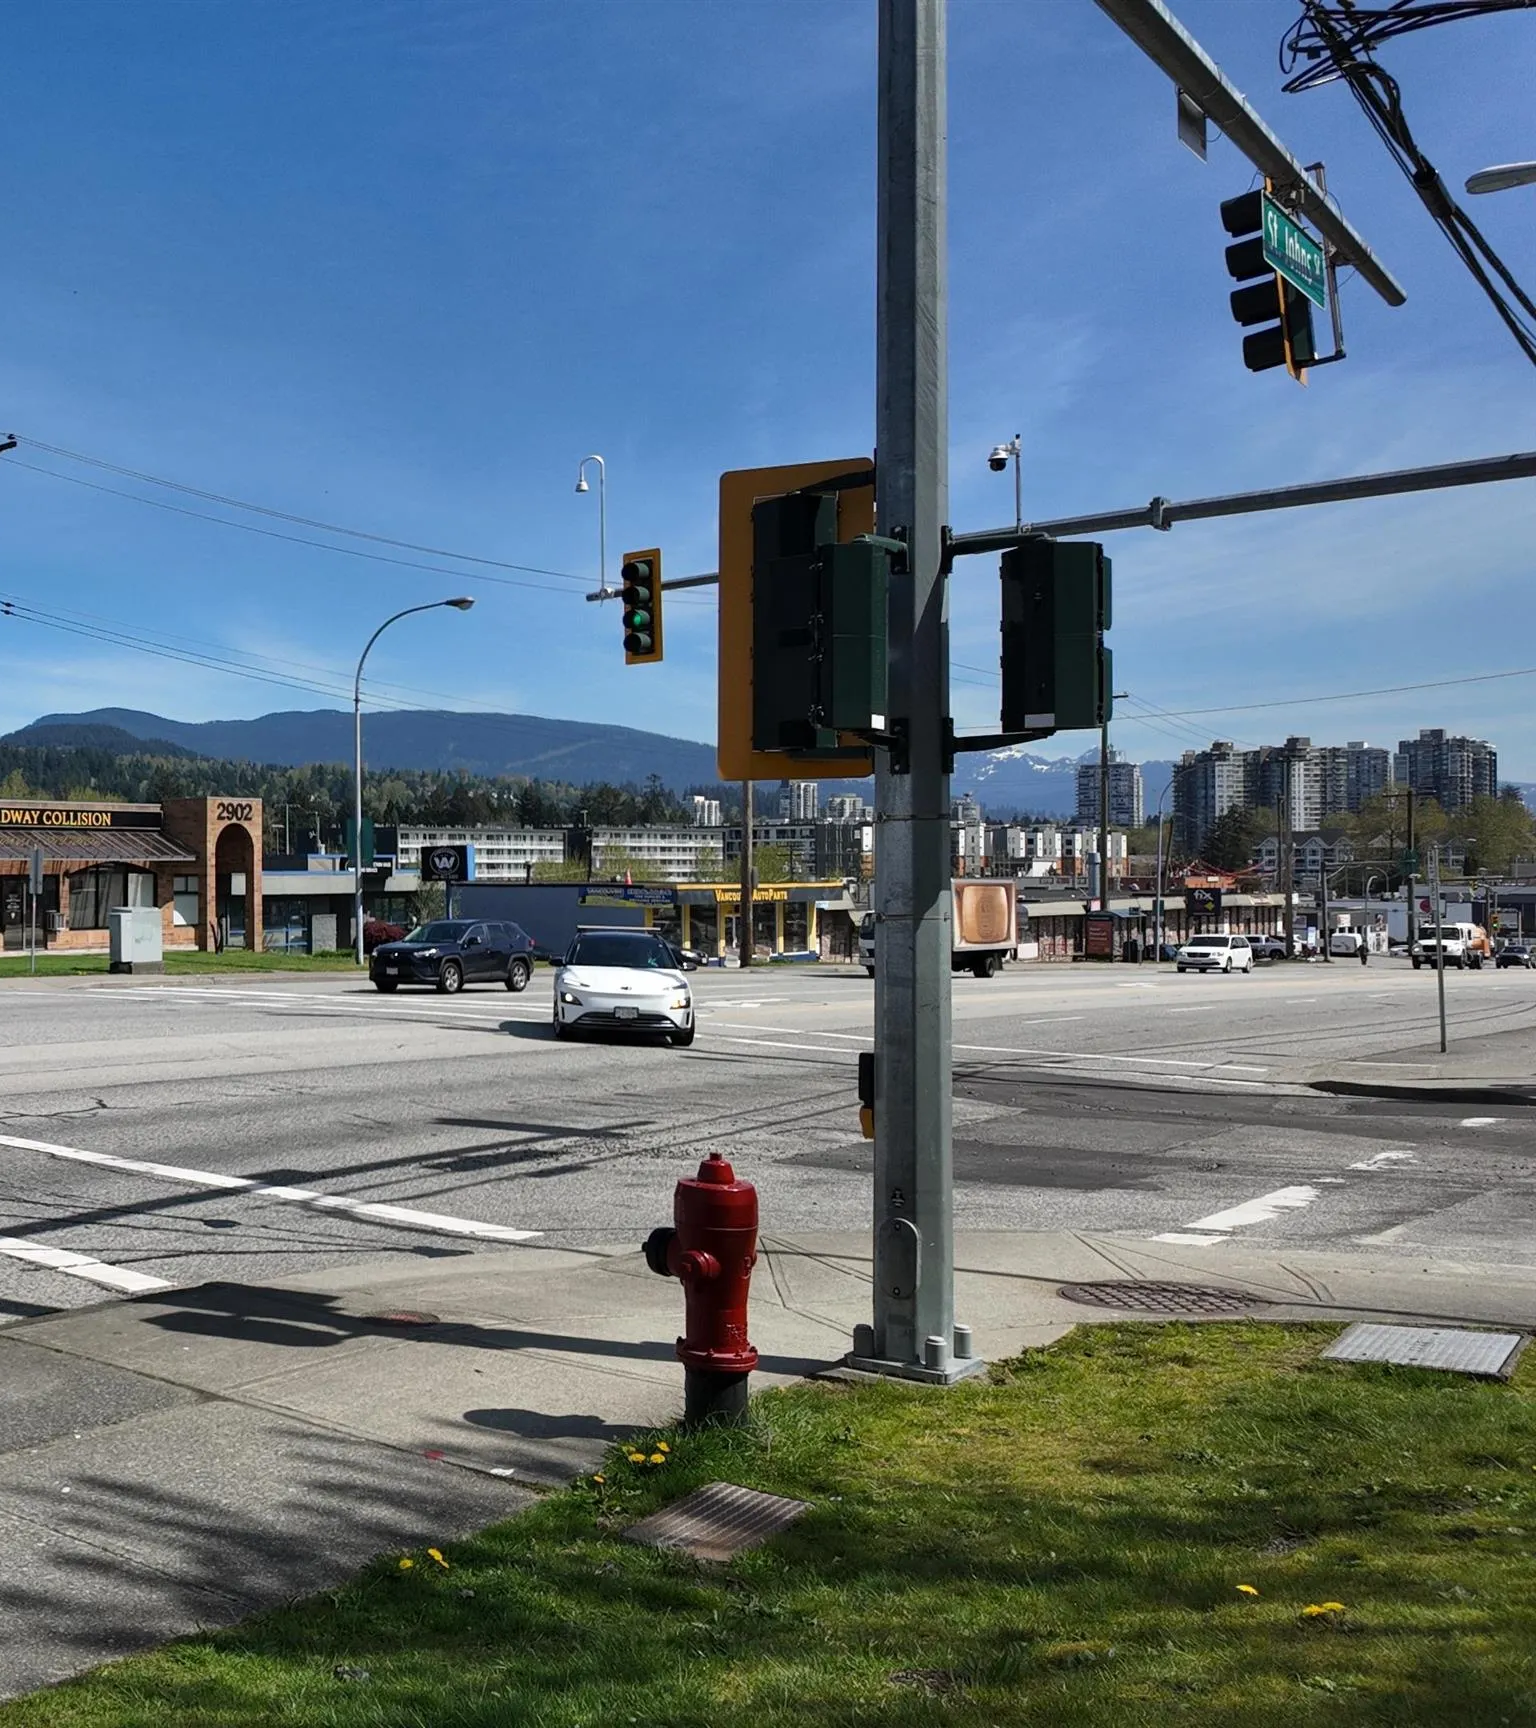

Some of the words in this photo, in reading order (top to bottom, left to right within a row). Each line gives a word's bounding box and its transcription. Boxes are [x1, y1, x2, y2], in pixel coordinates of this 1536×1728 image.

[43, 811, 111, 826] COLLISION
[217, 802, 252, 821] 2902
[1193, 889, 1214, 901] fix
